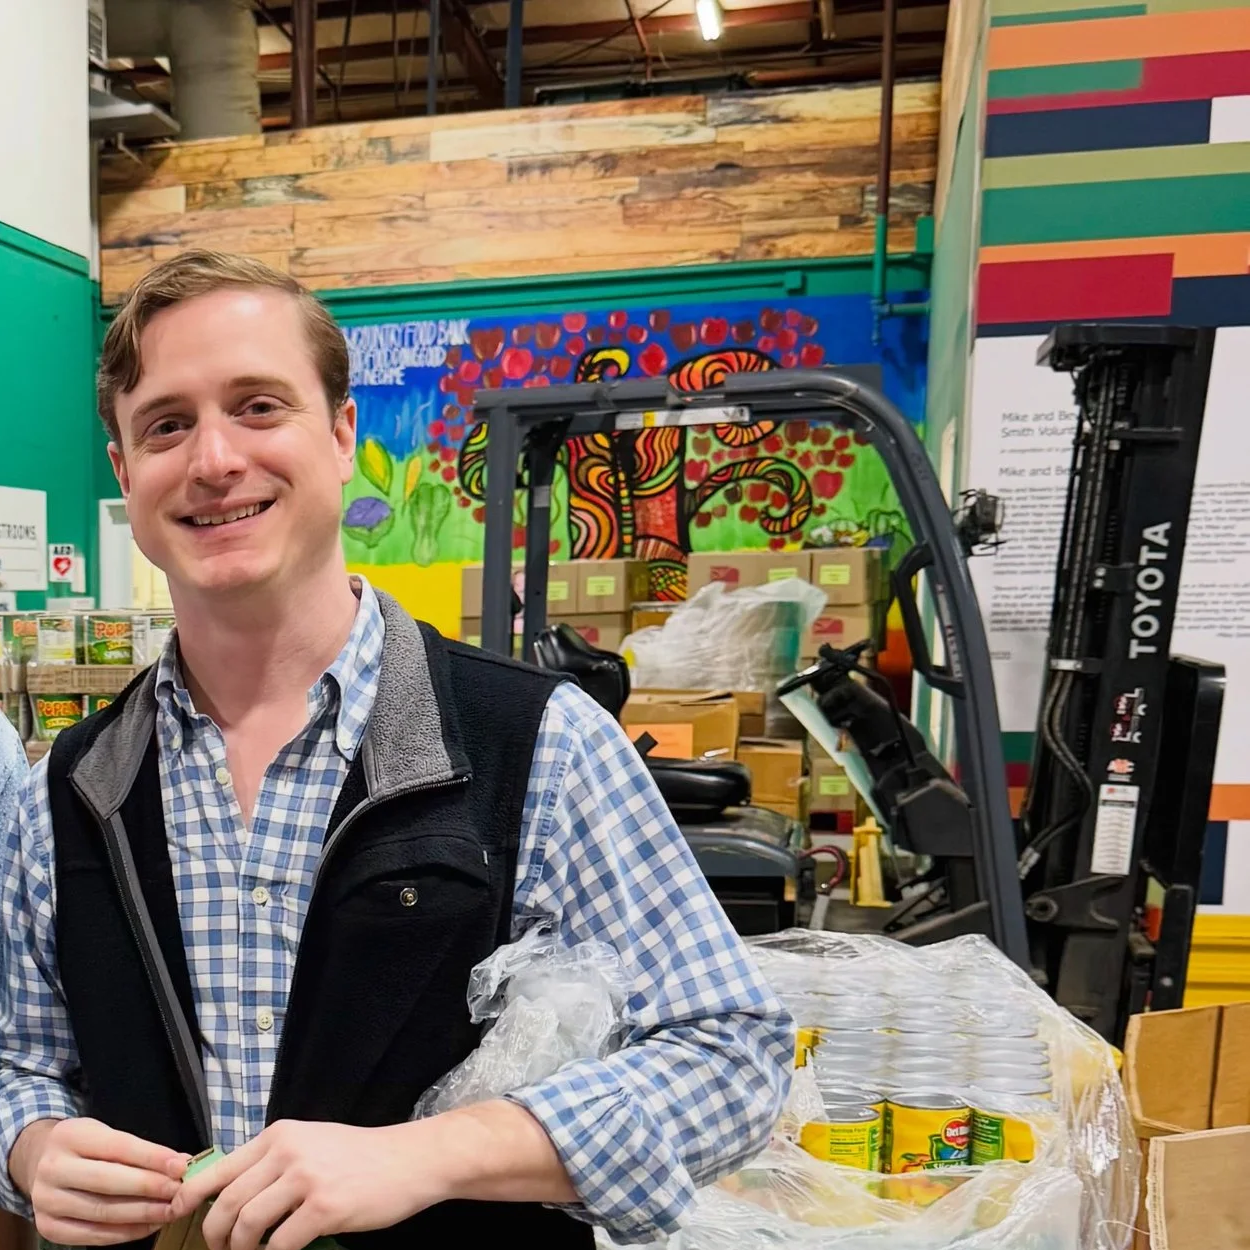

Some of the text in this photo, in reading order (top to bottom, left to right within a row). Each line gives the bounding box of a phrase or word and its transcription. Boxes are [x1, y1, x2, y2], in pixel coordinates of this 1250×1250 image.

[1002, 412, 1028, 421] Mike
[1032, 411, 1054, 421] and
[999, 467, 1025, 477] Mike
[1029, 466, 1051, 476] and
[1129, 521, 1172, 660] TOYOTA
